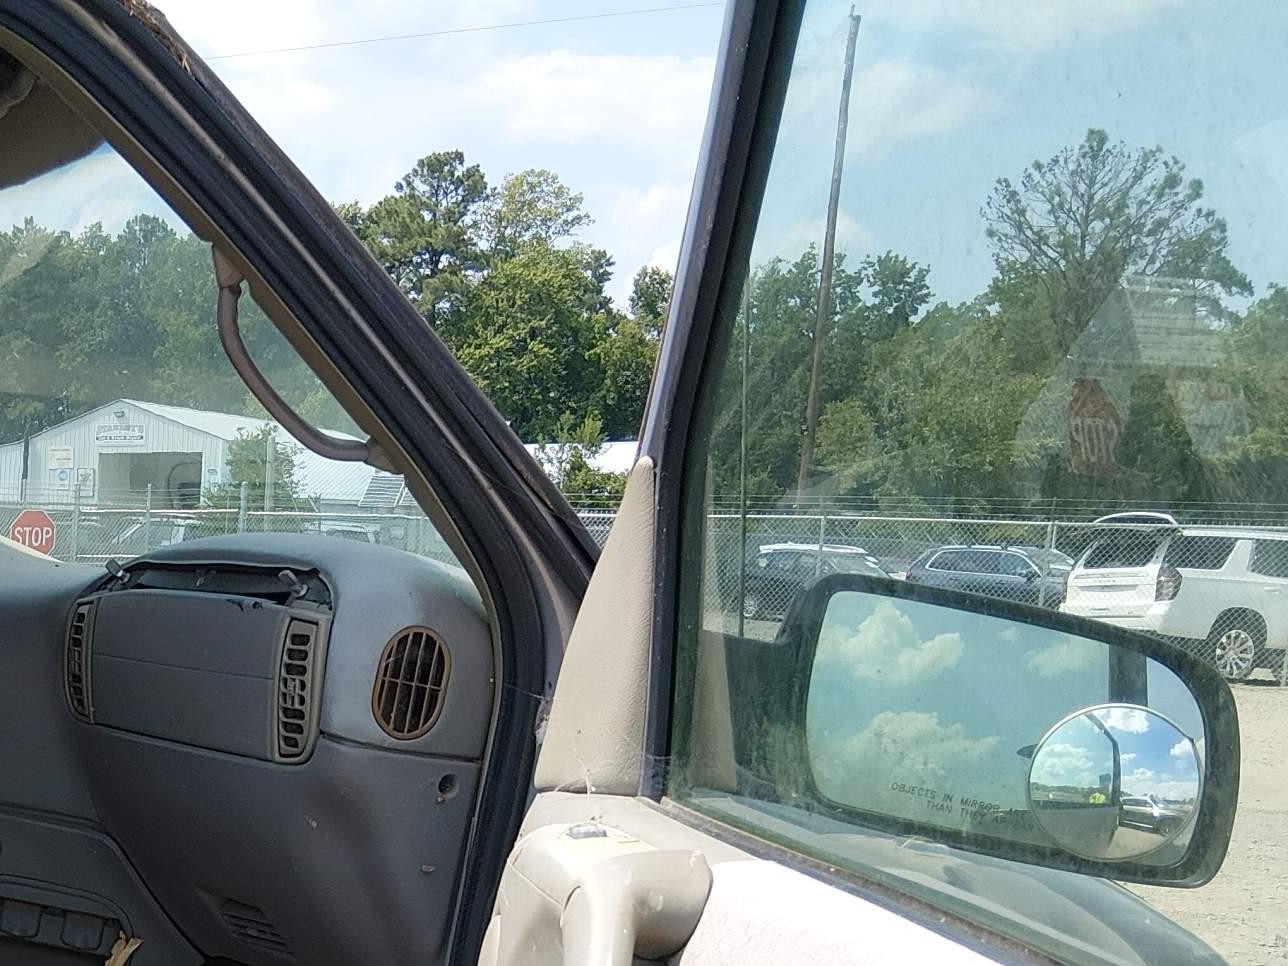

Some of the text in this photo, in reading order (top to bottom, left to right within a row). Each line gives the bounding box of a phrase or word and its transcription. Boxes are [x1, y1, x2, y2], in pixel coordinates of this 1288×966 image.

[14, 526, 53, 547] STOP
[891, 782, 937, 799] OBJECTS
[942, 793, 954, 802] IN
[926, 800, 953, 814] THAN
